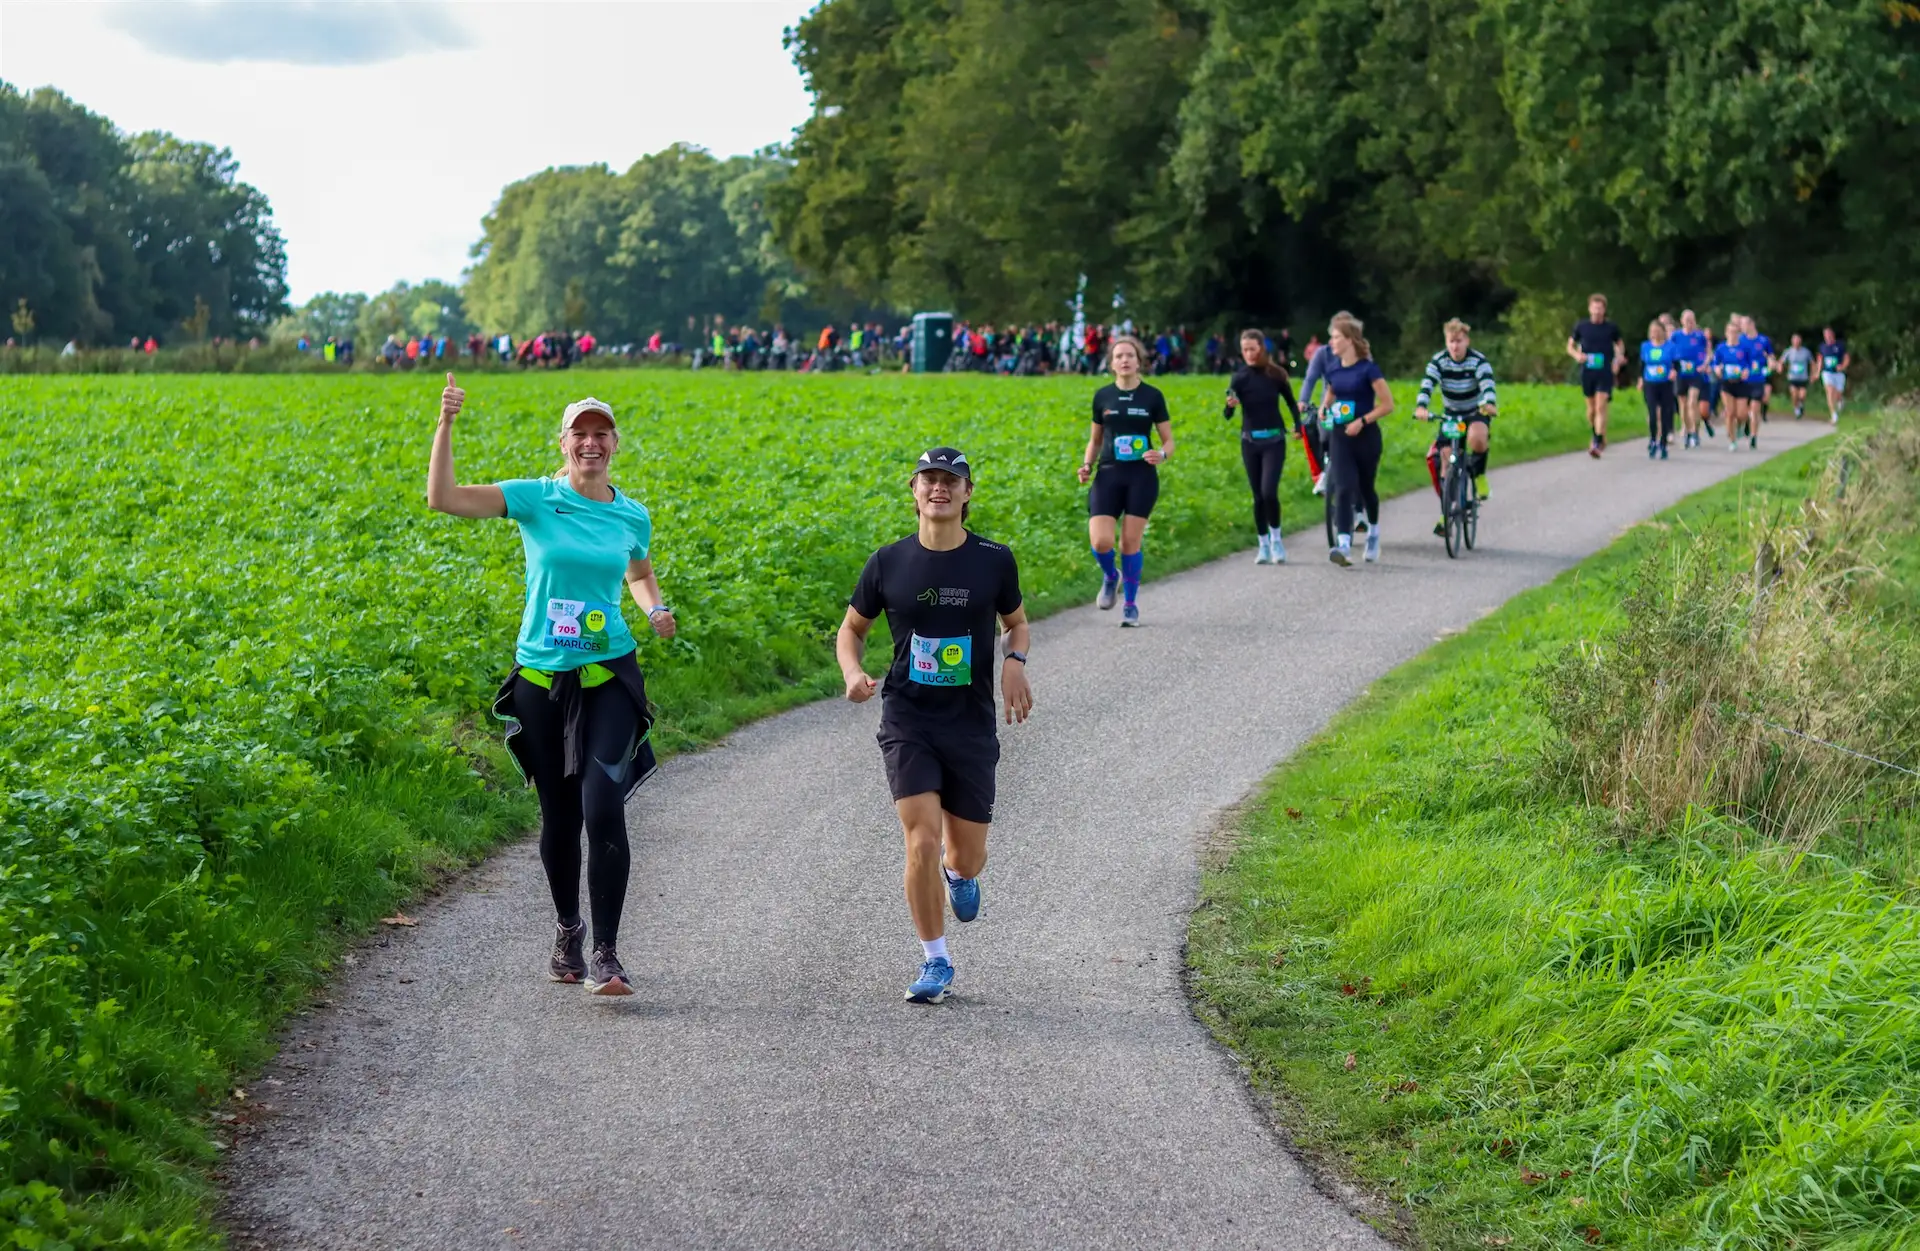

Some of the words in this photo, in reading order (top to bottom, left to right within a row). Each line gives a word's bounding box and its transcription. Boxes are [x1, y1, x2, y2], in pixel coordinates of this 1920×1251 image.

[939, 587, 970, 597] KIEVIT
[939, 597, 969, 607] SPORT
[557, 625, 577, 635] 705
[553, 638, 603, 651] MARLOES
[917, 660, 933, 670] 133
[922, 673, 957, 684] LUCAS
